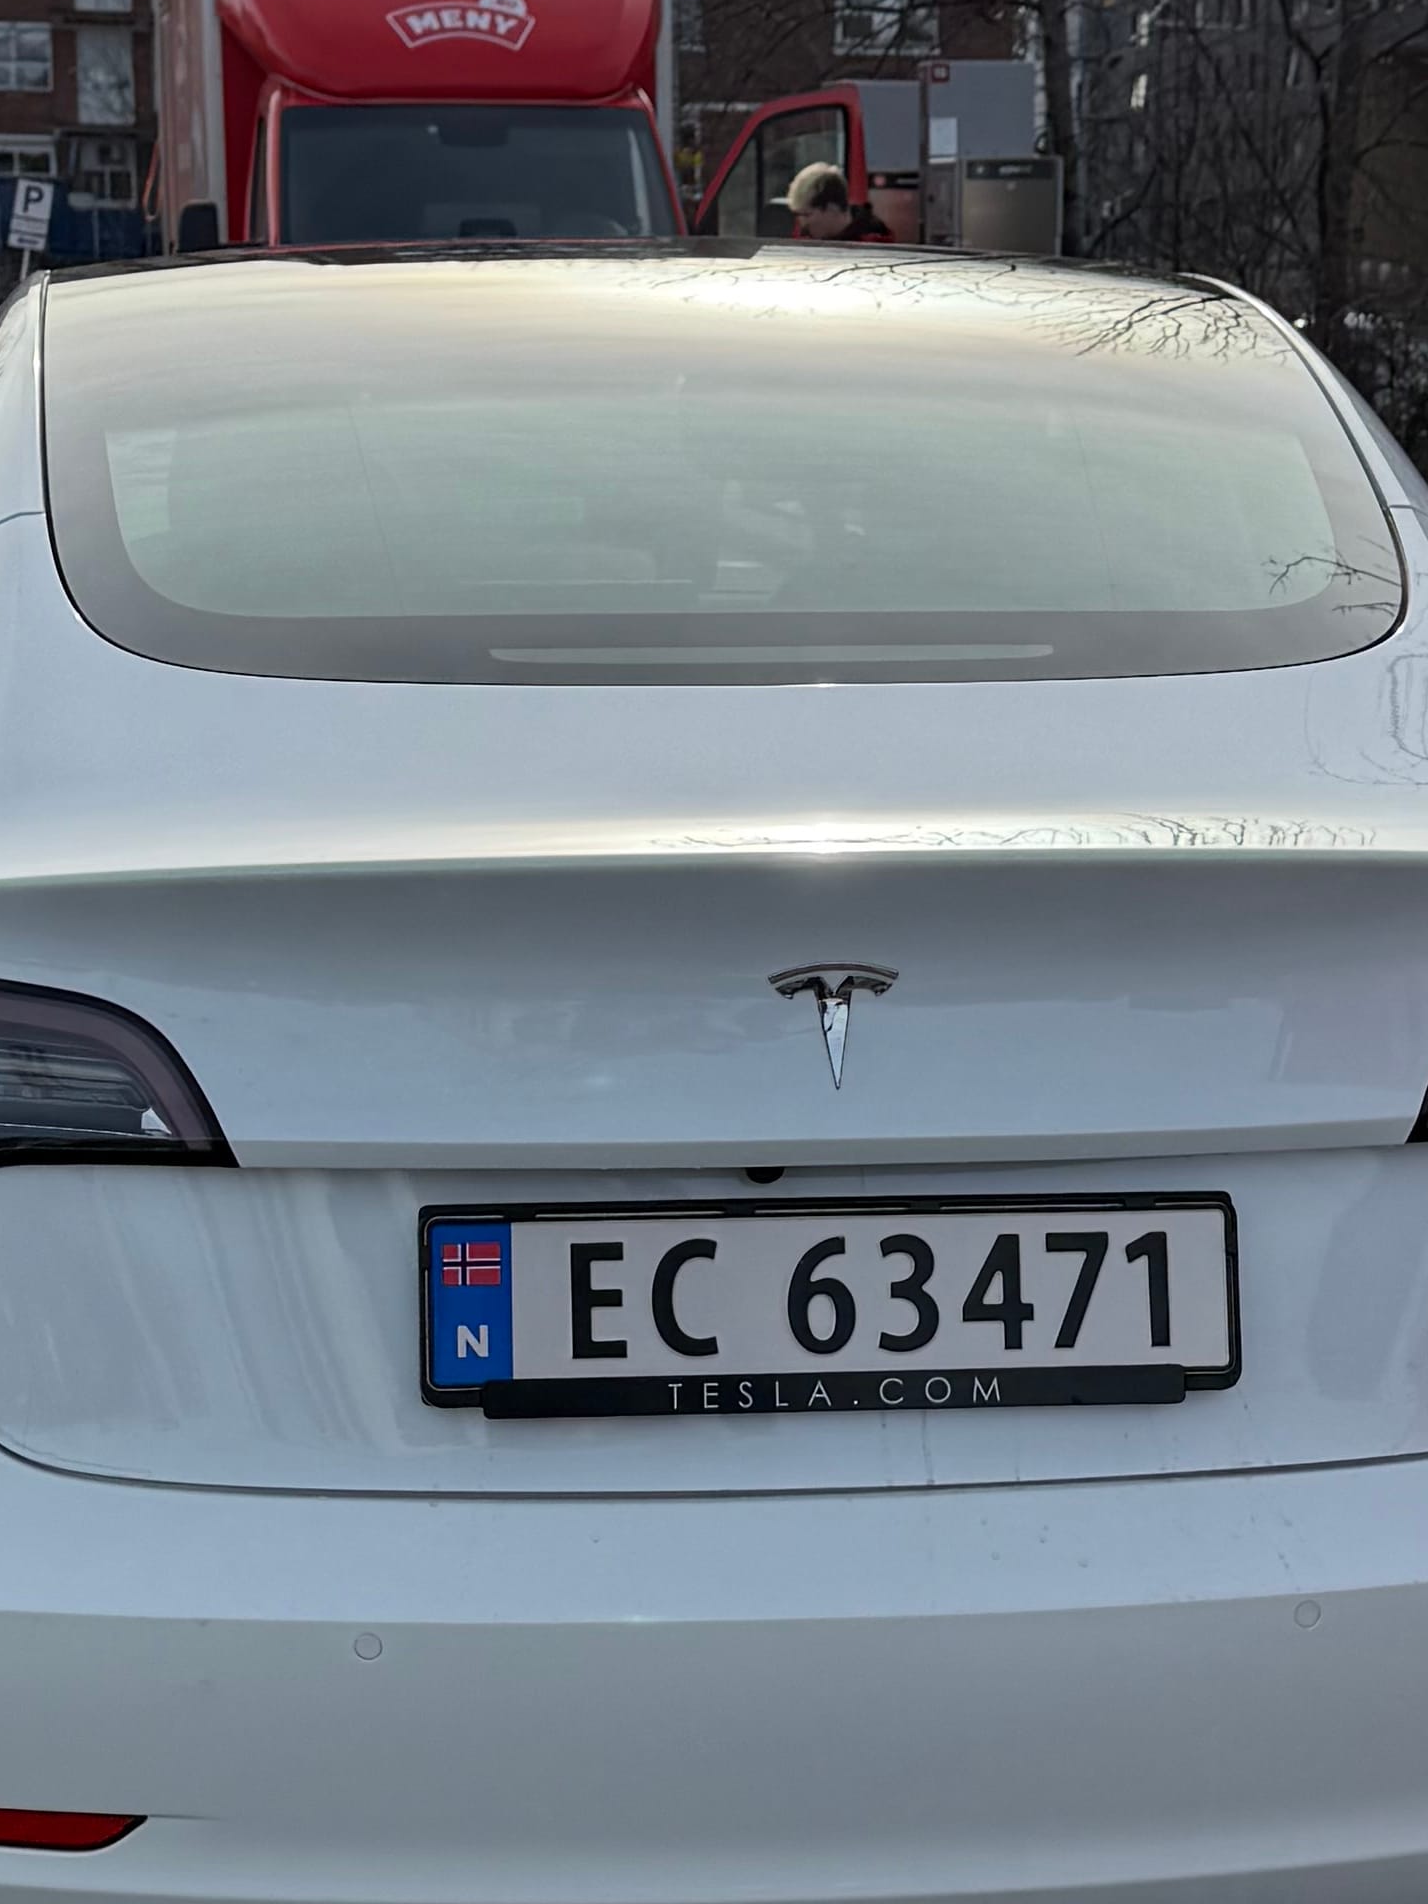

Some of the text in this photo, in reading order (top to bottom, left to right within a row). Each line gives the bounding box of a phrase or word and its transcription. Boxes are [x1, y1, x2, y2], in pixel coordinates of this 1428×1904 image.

[405, 9, 519, 36] MENY
[23, 184, 44, 213] P
[571, 1231, 1171, 1360] EC 63471
[457, 1324, 490, 1359] N
[668, 1376, 1002, 1411] TESLA.COM
